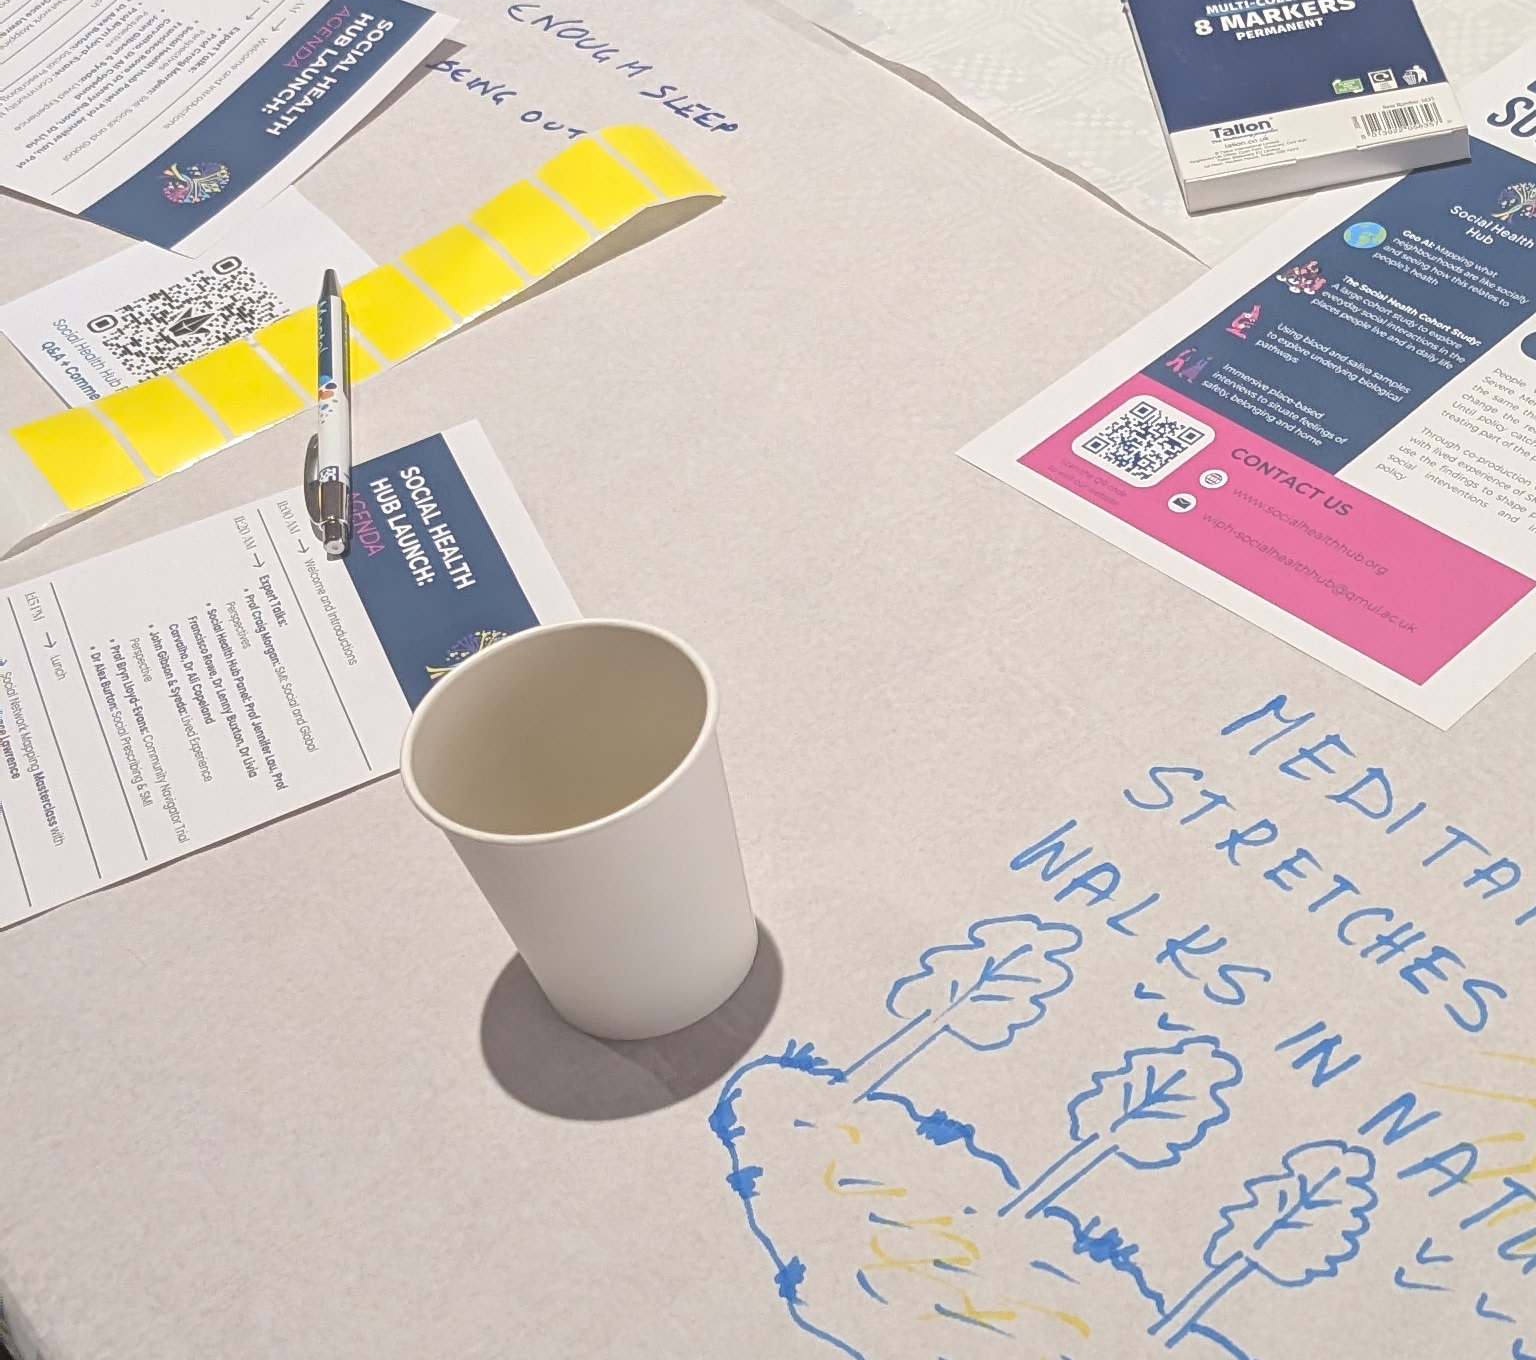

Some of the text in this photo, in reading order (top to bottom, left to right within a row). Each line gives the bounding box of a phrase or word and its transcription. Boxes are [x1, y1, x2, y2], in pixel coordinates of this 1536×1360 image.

[282, 5, 350, 68] AGENDA
[1194, 20, 1213, 36] 8
[1236, 18, 1324, 40] PERMANENT
[261, 13, 373, 115] HUB LAUNCH:
[266, 20, 394, 136] SOCIAL HEALTH
[425, 60, 588, 140] BEING OUT
[639, 85, 738, 132] SLEEP
[1210, 118, 1272, 139] Tallon
[1450, 206, 1534, 248] Social Health
[1465, 227, 1494, 244] Hub
[1343, 275, 1482, 346] The Social Health Cohort Study:
[41, 340, 62, 362] Q&A
[65, 365, 102, 402] Comme
[53, 318, 123, 388] Social Health Hub
[1231, 448, 1354, 516] CONTACT US
[285, 520, 301, 534] AM
[370, 477, 435, 586] HUB LAUNCH:
[400, 466, 476, 590] SOCIAL HEALTH
[226, 601, 251, 649] Perspectives
[244, 594, 281, 667] Prof Craig Morgan:
[259, 574, 288, 628] Expert Talks:
[304, 558, 358, 666] Welcome and introductions
[50, 654, 67, 681] Lunch
[1123, 765, 1507, 1033] STRETCHES
[1010, 819, 1271, 1006] WALKS
[1274, 1021, 1361, 1089] IN
